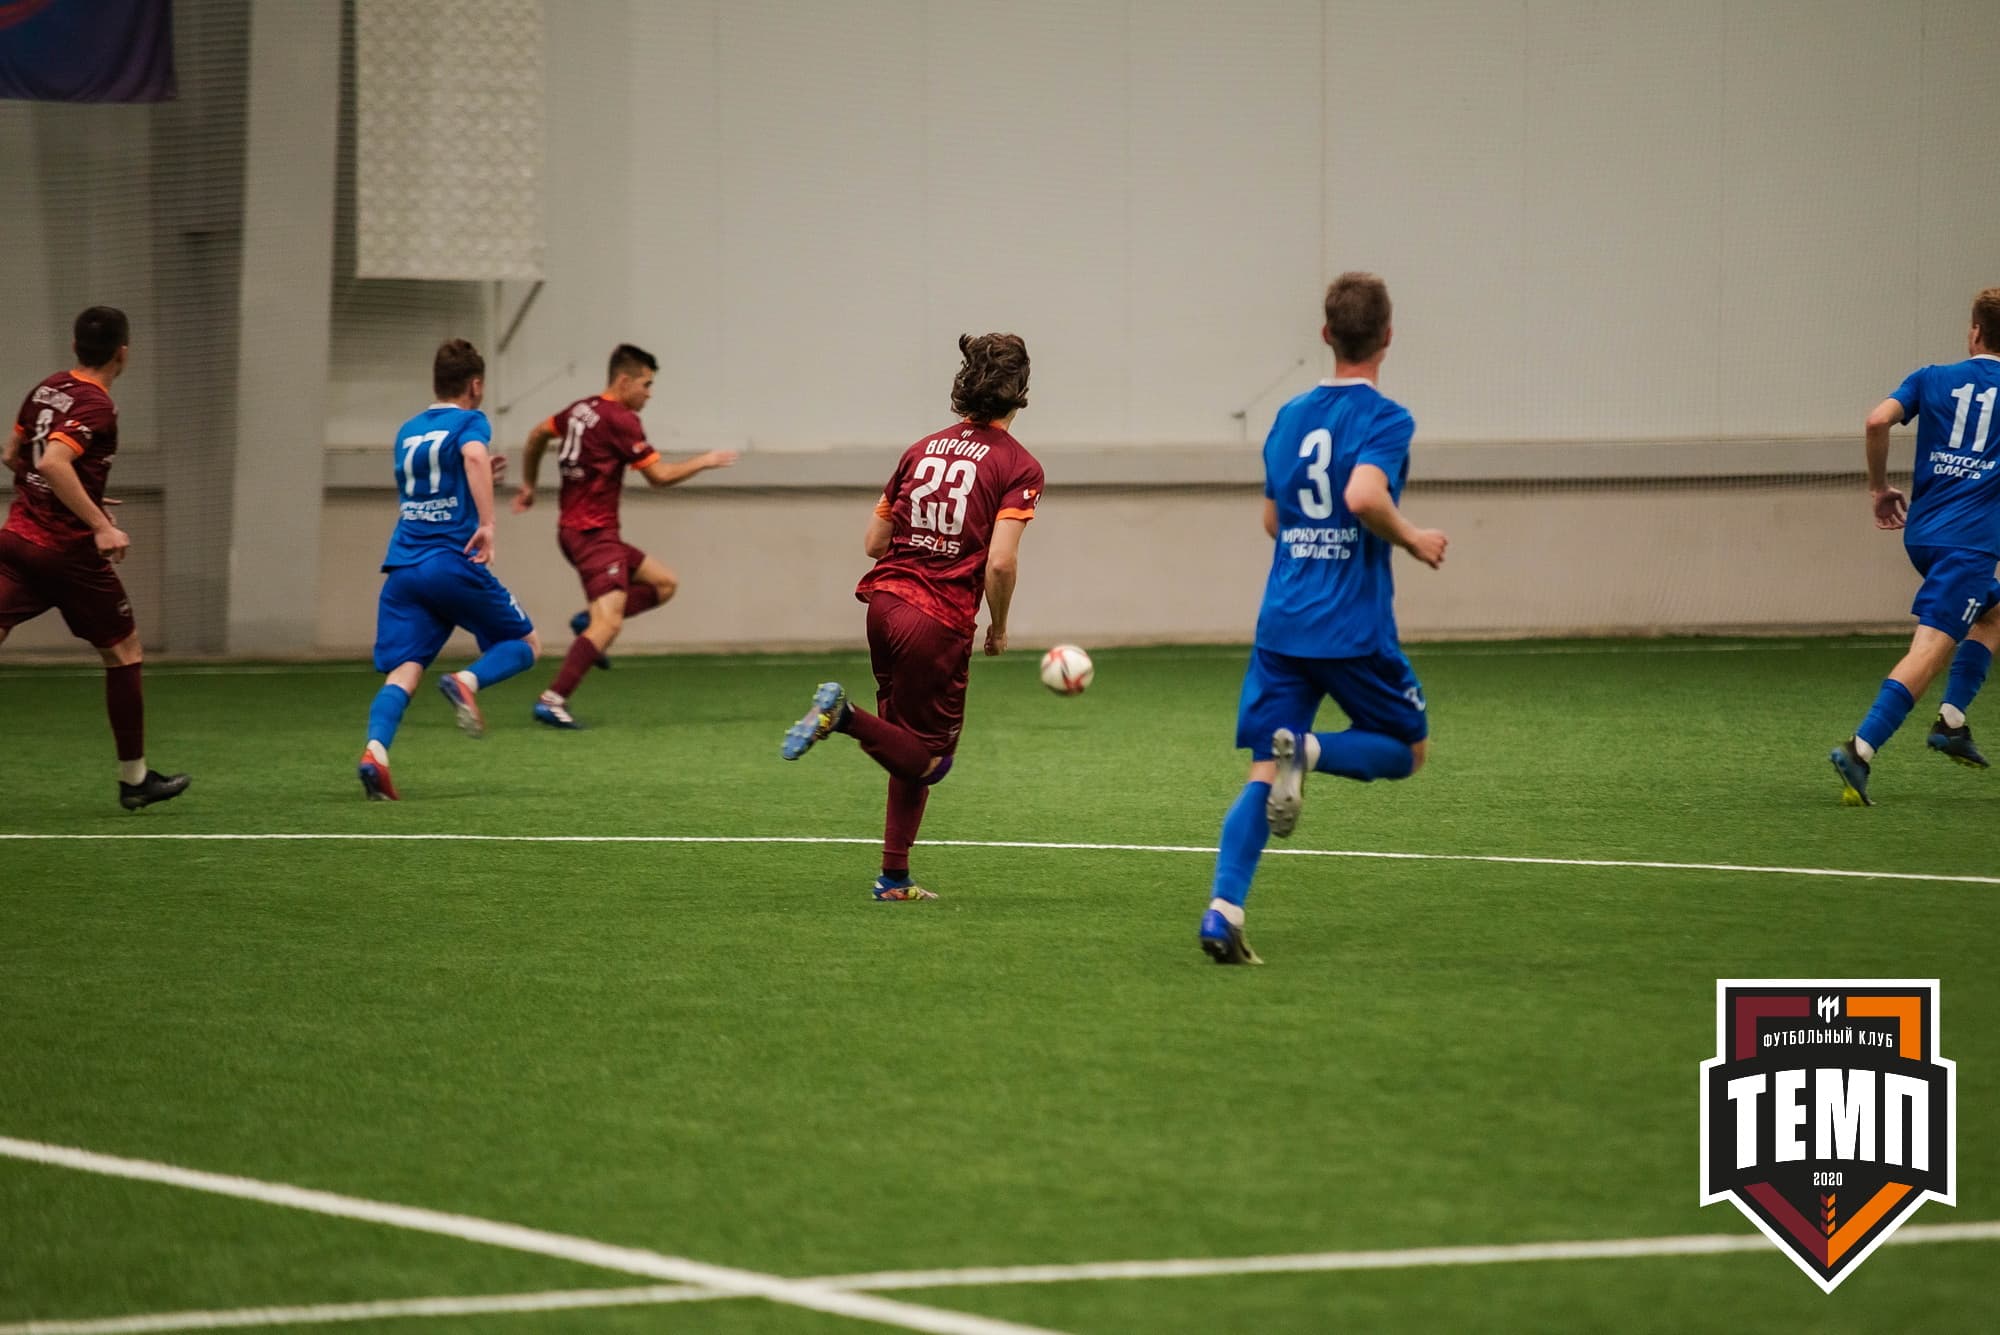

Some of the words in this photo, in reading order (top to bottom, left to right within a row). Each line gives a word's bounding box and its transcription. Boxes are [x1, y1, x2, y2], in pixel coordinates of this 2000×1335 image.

[924, 438, 991, 462] ВОРОНА
[1948, 383, 1998, 453] 11
[402, 430, 450, 497] 77
[910, 457, 977, 535] 23
[1297, 428, 1333, 520] 3
[1281, 527, 1358, 543] ИРКУТСКАЯ
[1290, 543, 1351, 560] ОБЛАСТЬ
